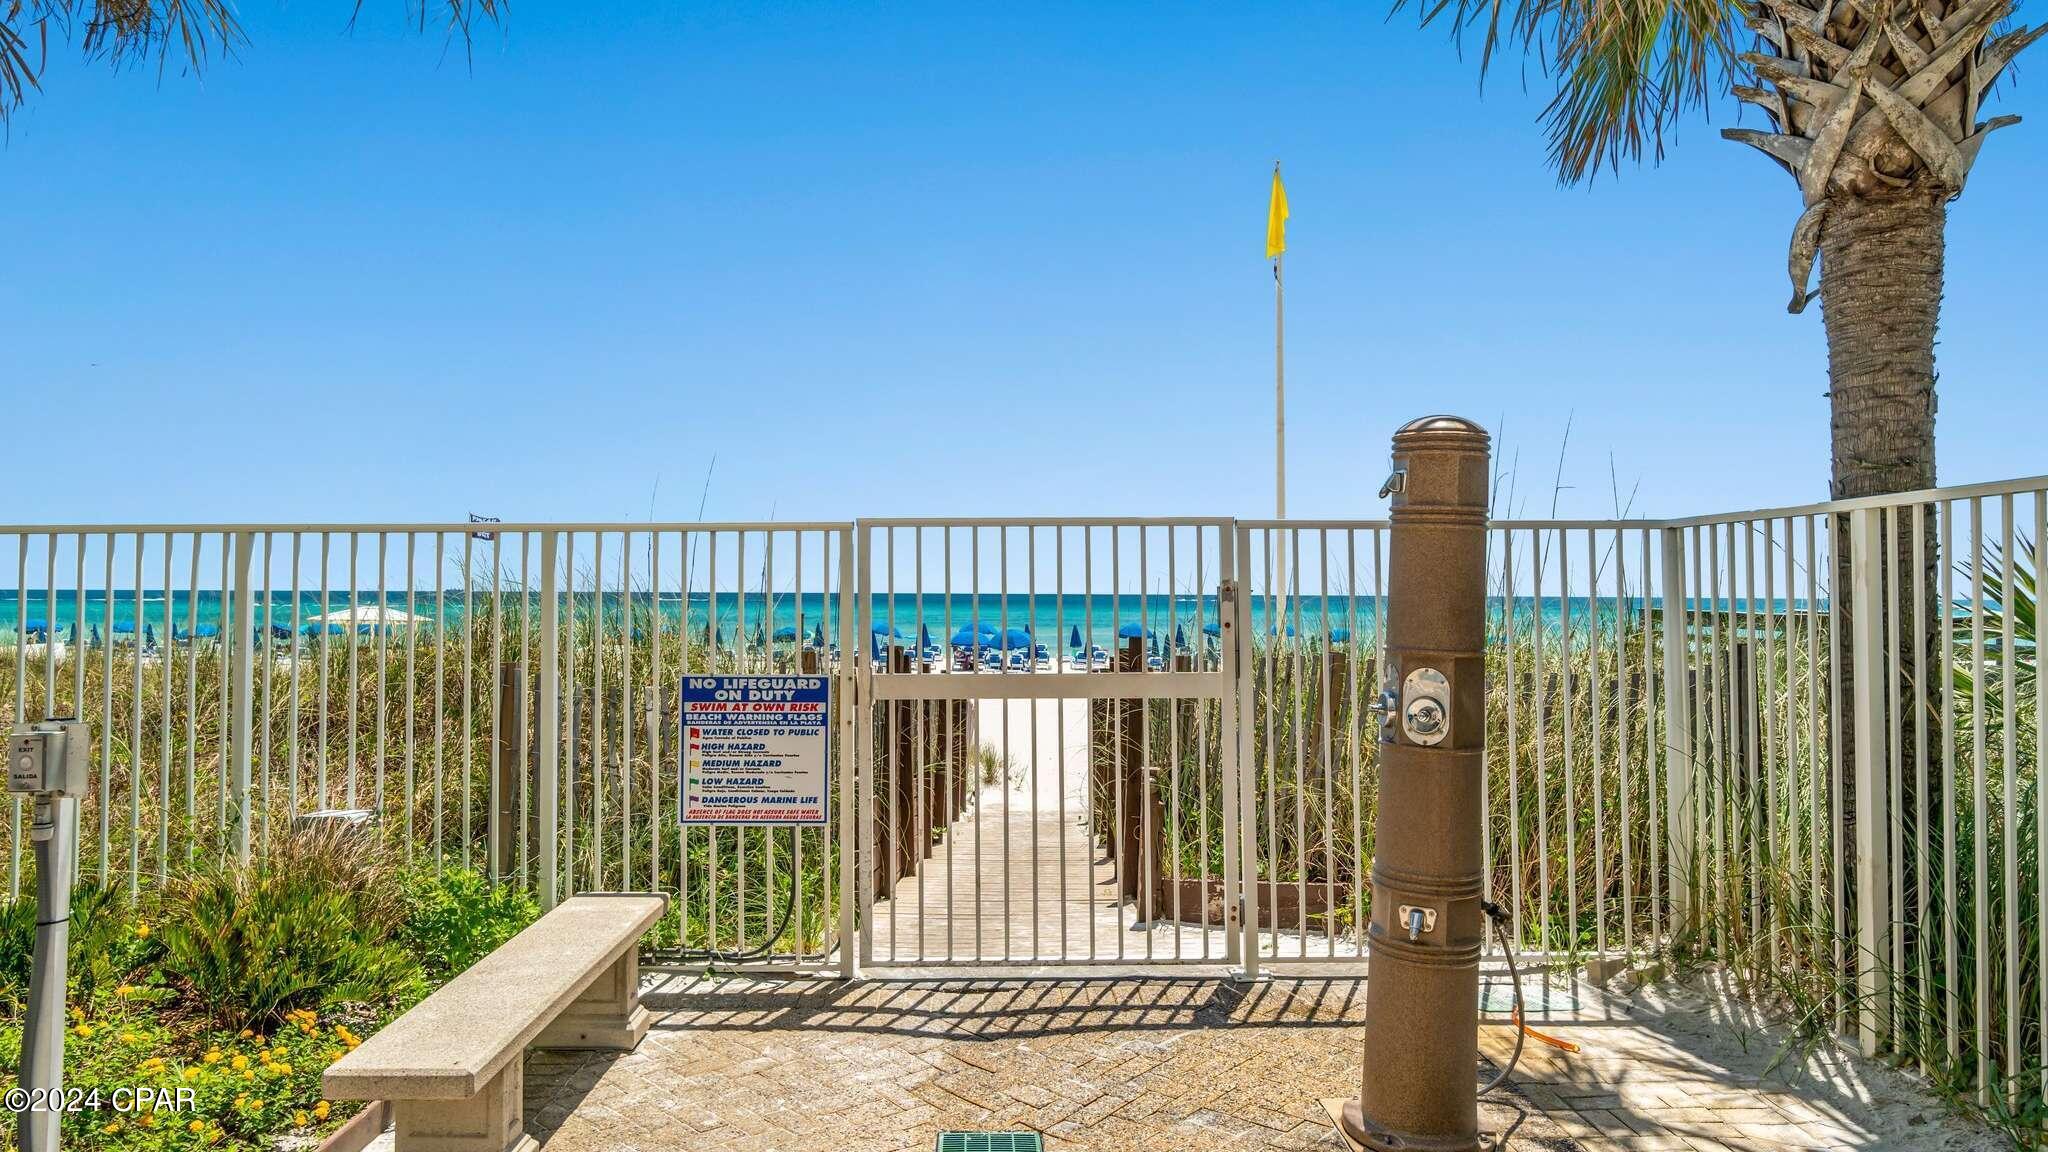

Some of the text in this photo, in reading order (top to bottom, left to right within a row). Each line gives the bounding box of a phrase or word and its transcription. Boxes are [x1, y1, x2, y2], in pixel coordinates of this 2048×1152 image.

[690, 679, 821, 689] NO LIFEGUARD
[715, 690, 796, 701] ON DUTY
[691, 703, 819, 711] SWIM AT OWN RISK
